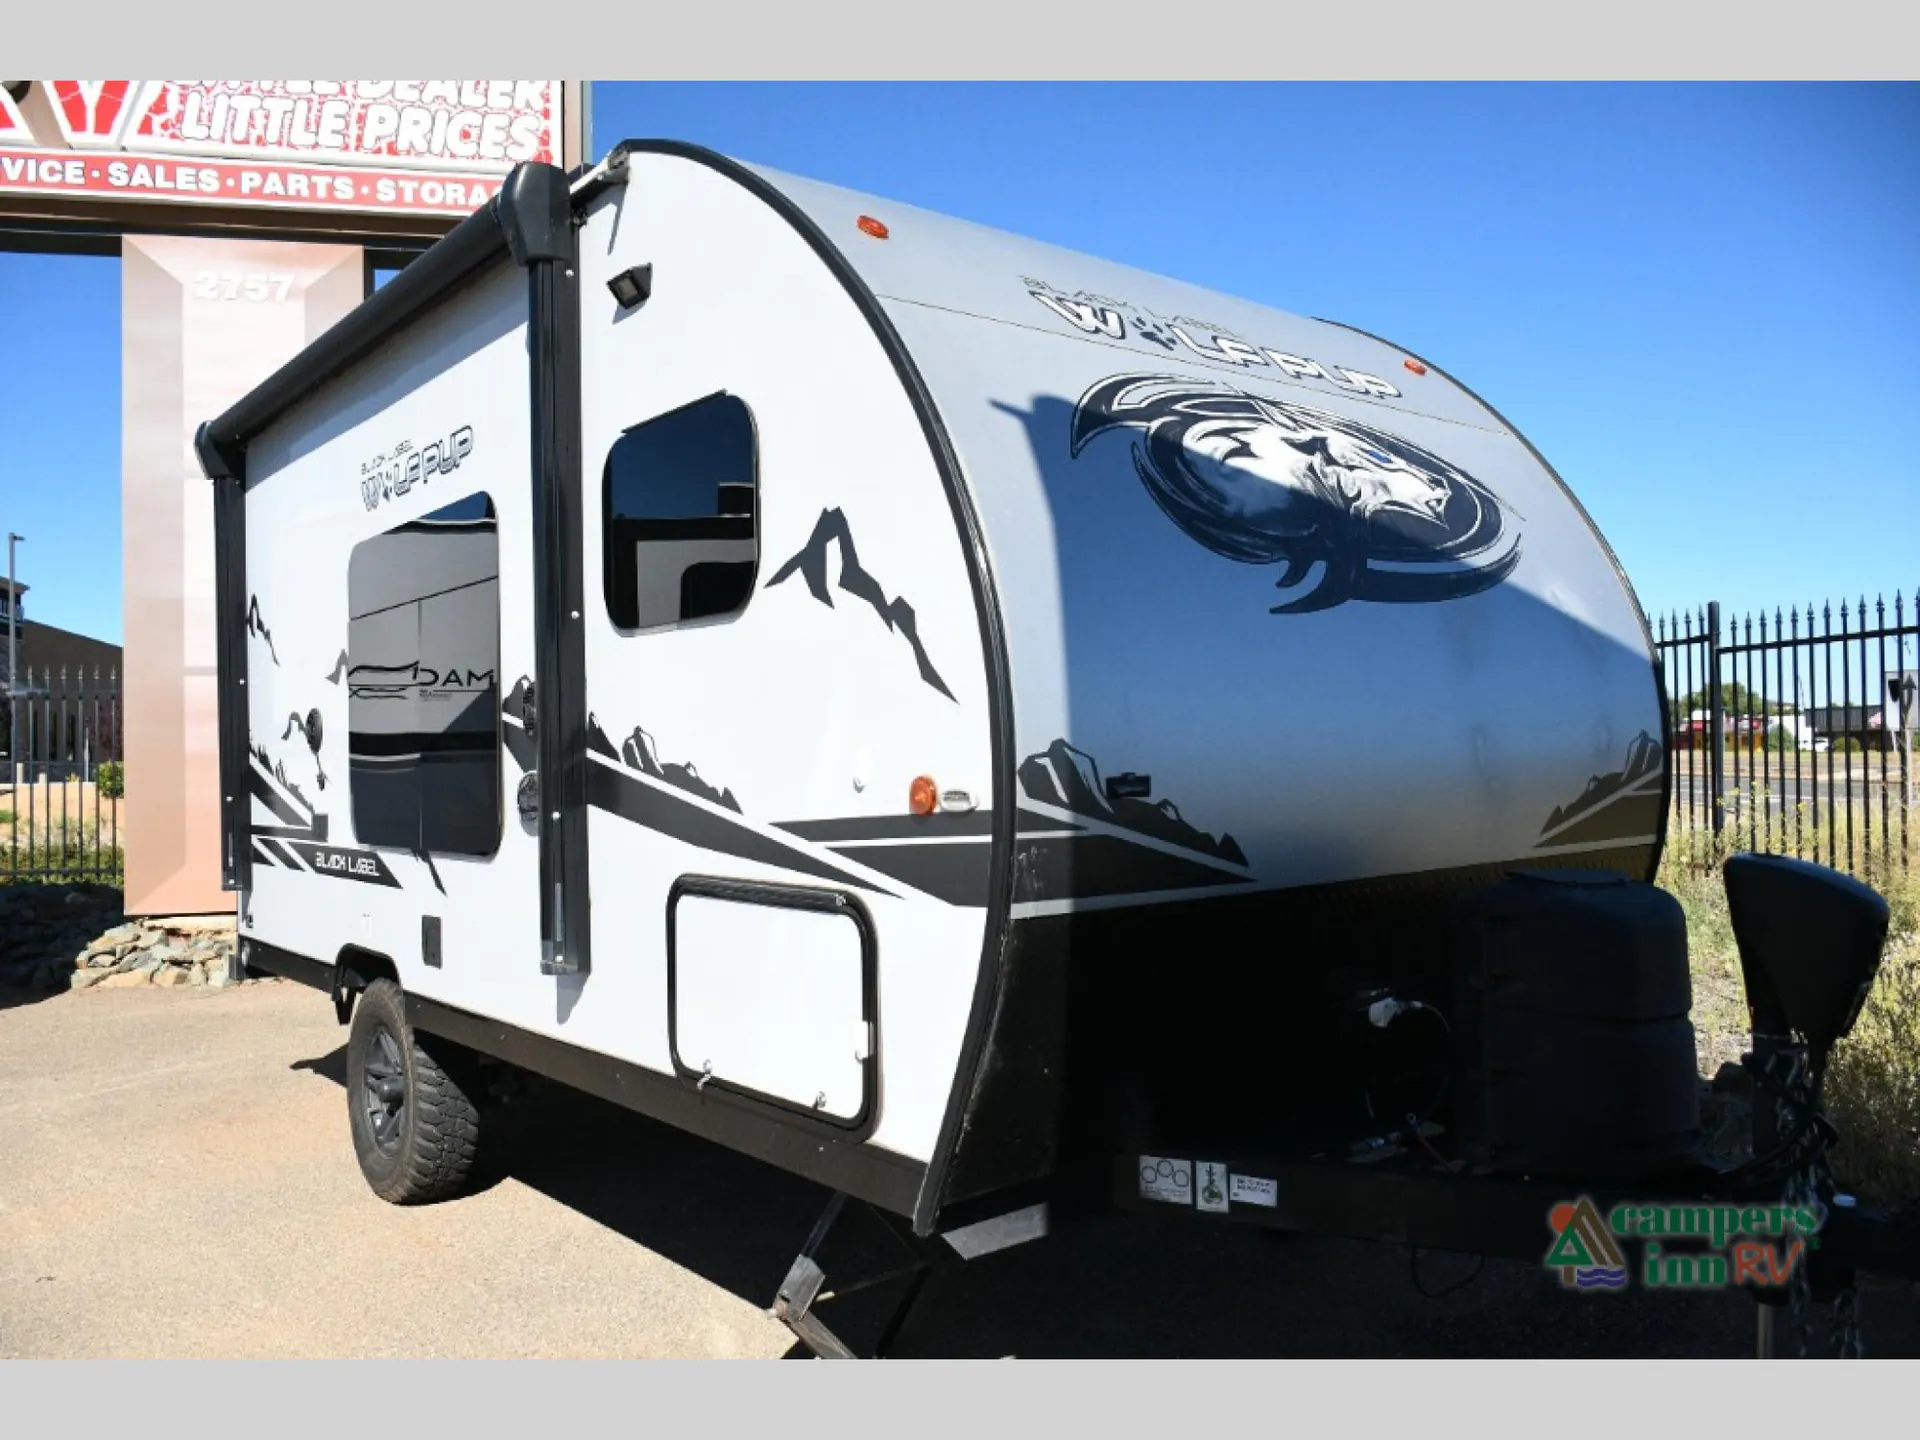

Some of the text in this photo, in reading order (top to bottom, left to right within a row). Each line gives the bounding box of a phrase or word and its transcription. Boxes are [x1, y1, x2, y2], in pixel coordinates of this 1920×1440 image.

[181, 90, 541, 162] LITTLE PRICES
[107, 161, 221, 193] SALES
[241, 171, 355, 200] PARTS
[193, 270, 295, 303] 2757
[315, 851, 379, 876] BLACK LABEL
